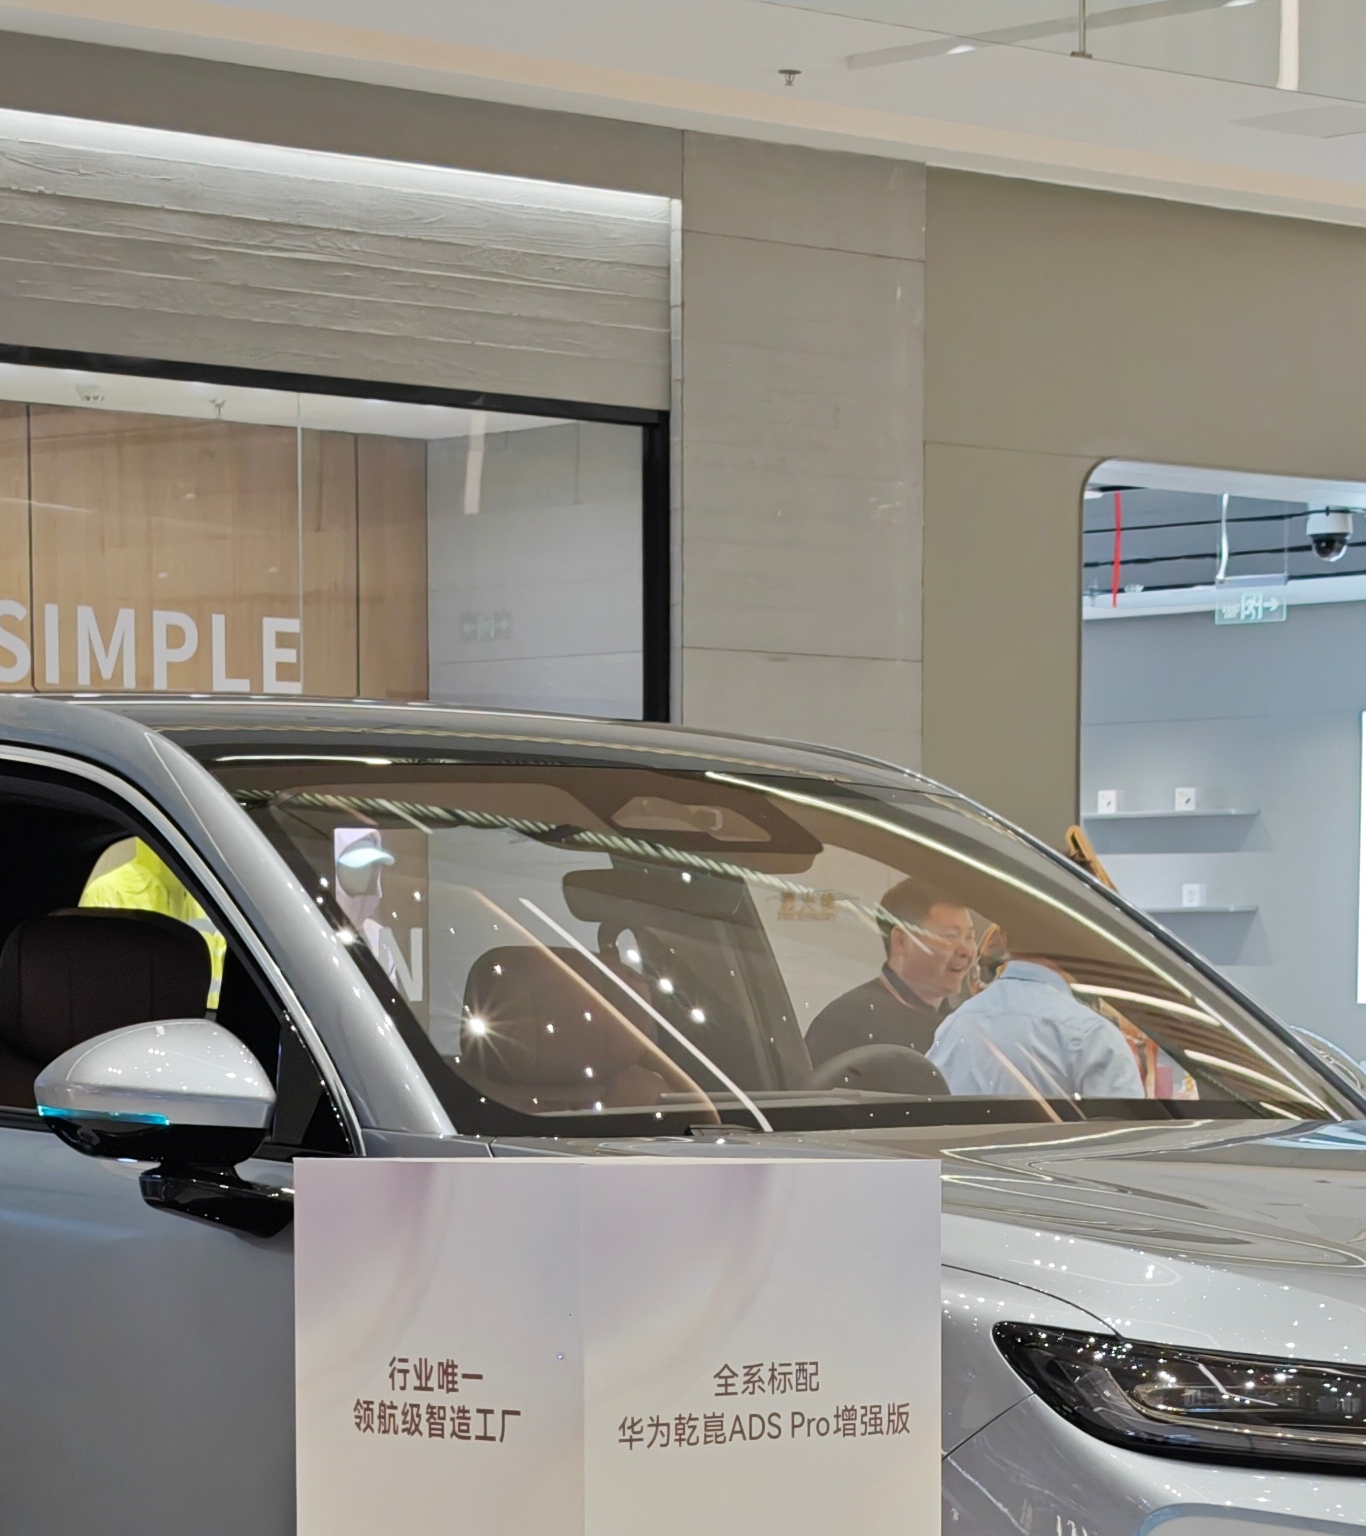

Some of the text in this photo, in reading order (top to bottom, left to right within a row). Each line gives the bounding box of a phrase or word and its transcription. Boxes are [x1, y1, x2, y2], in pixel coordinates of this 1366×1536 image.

[387, 1355, 484, 1394] 行业唯一
[712, 1360, 821, 1397] 全系标配
[352, 1398, 522, 1443] 领航级智造工厂
[617, 1402, 911, 1450] 华为乾崑ADS Pro增强版
